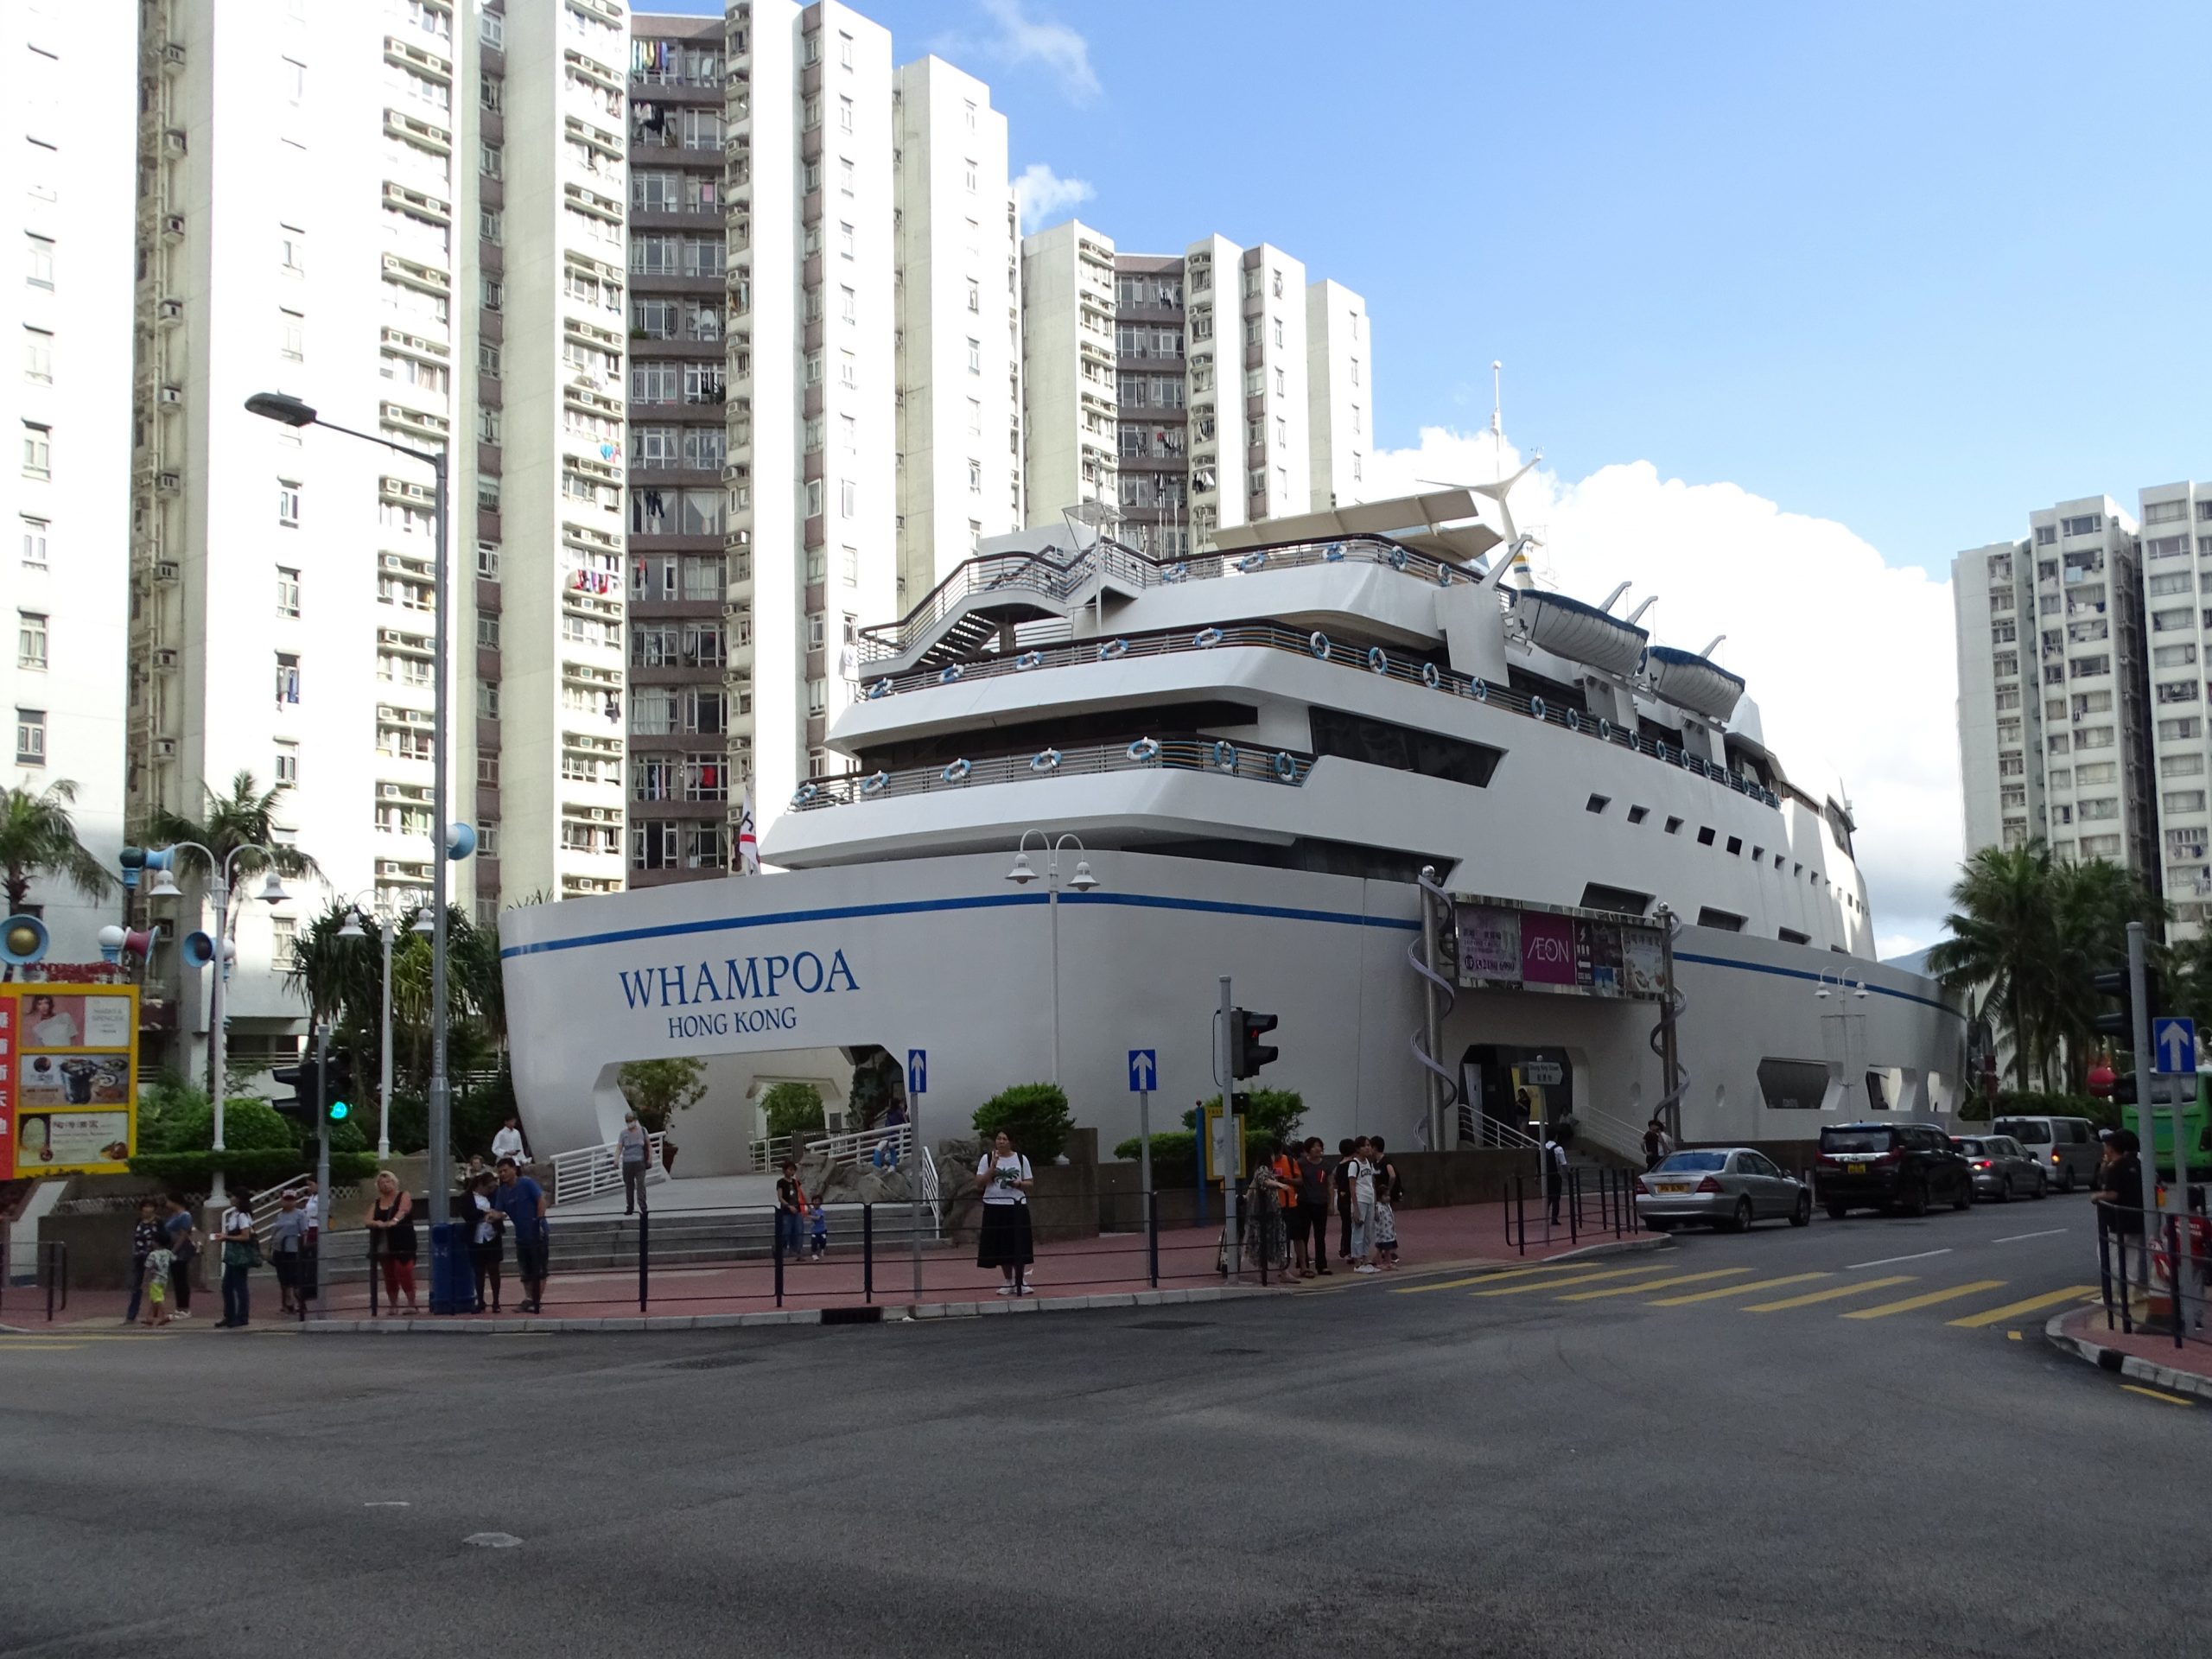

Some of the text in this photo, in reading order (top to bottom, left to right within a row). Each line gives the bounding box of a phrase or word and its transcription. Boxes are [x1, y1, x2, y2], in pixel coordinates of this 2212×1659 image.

[619, 948, 861, 1009] WHAMPOA
[668, 1007, 797, 1038] HONG KONG
